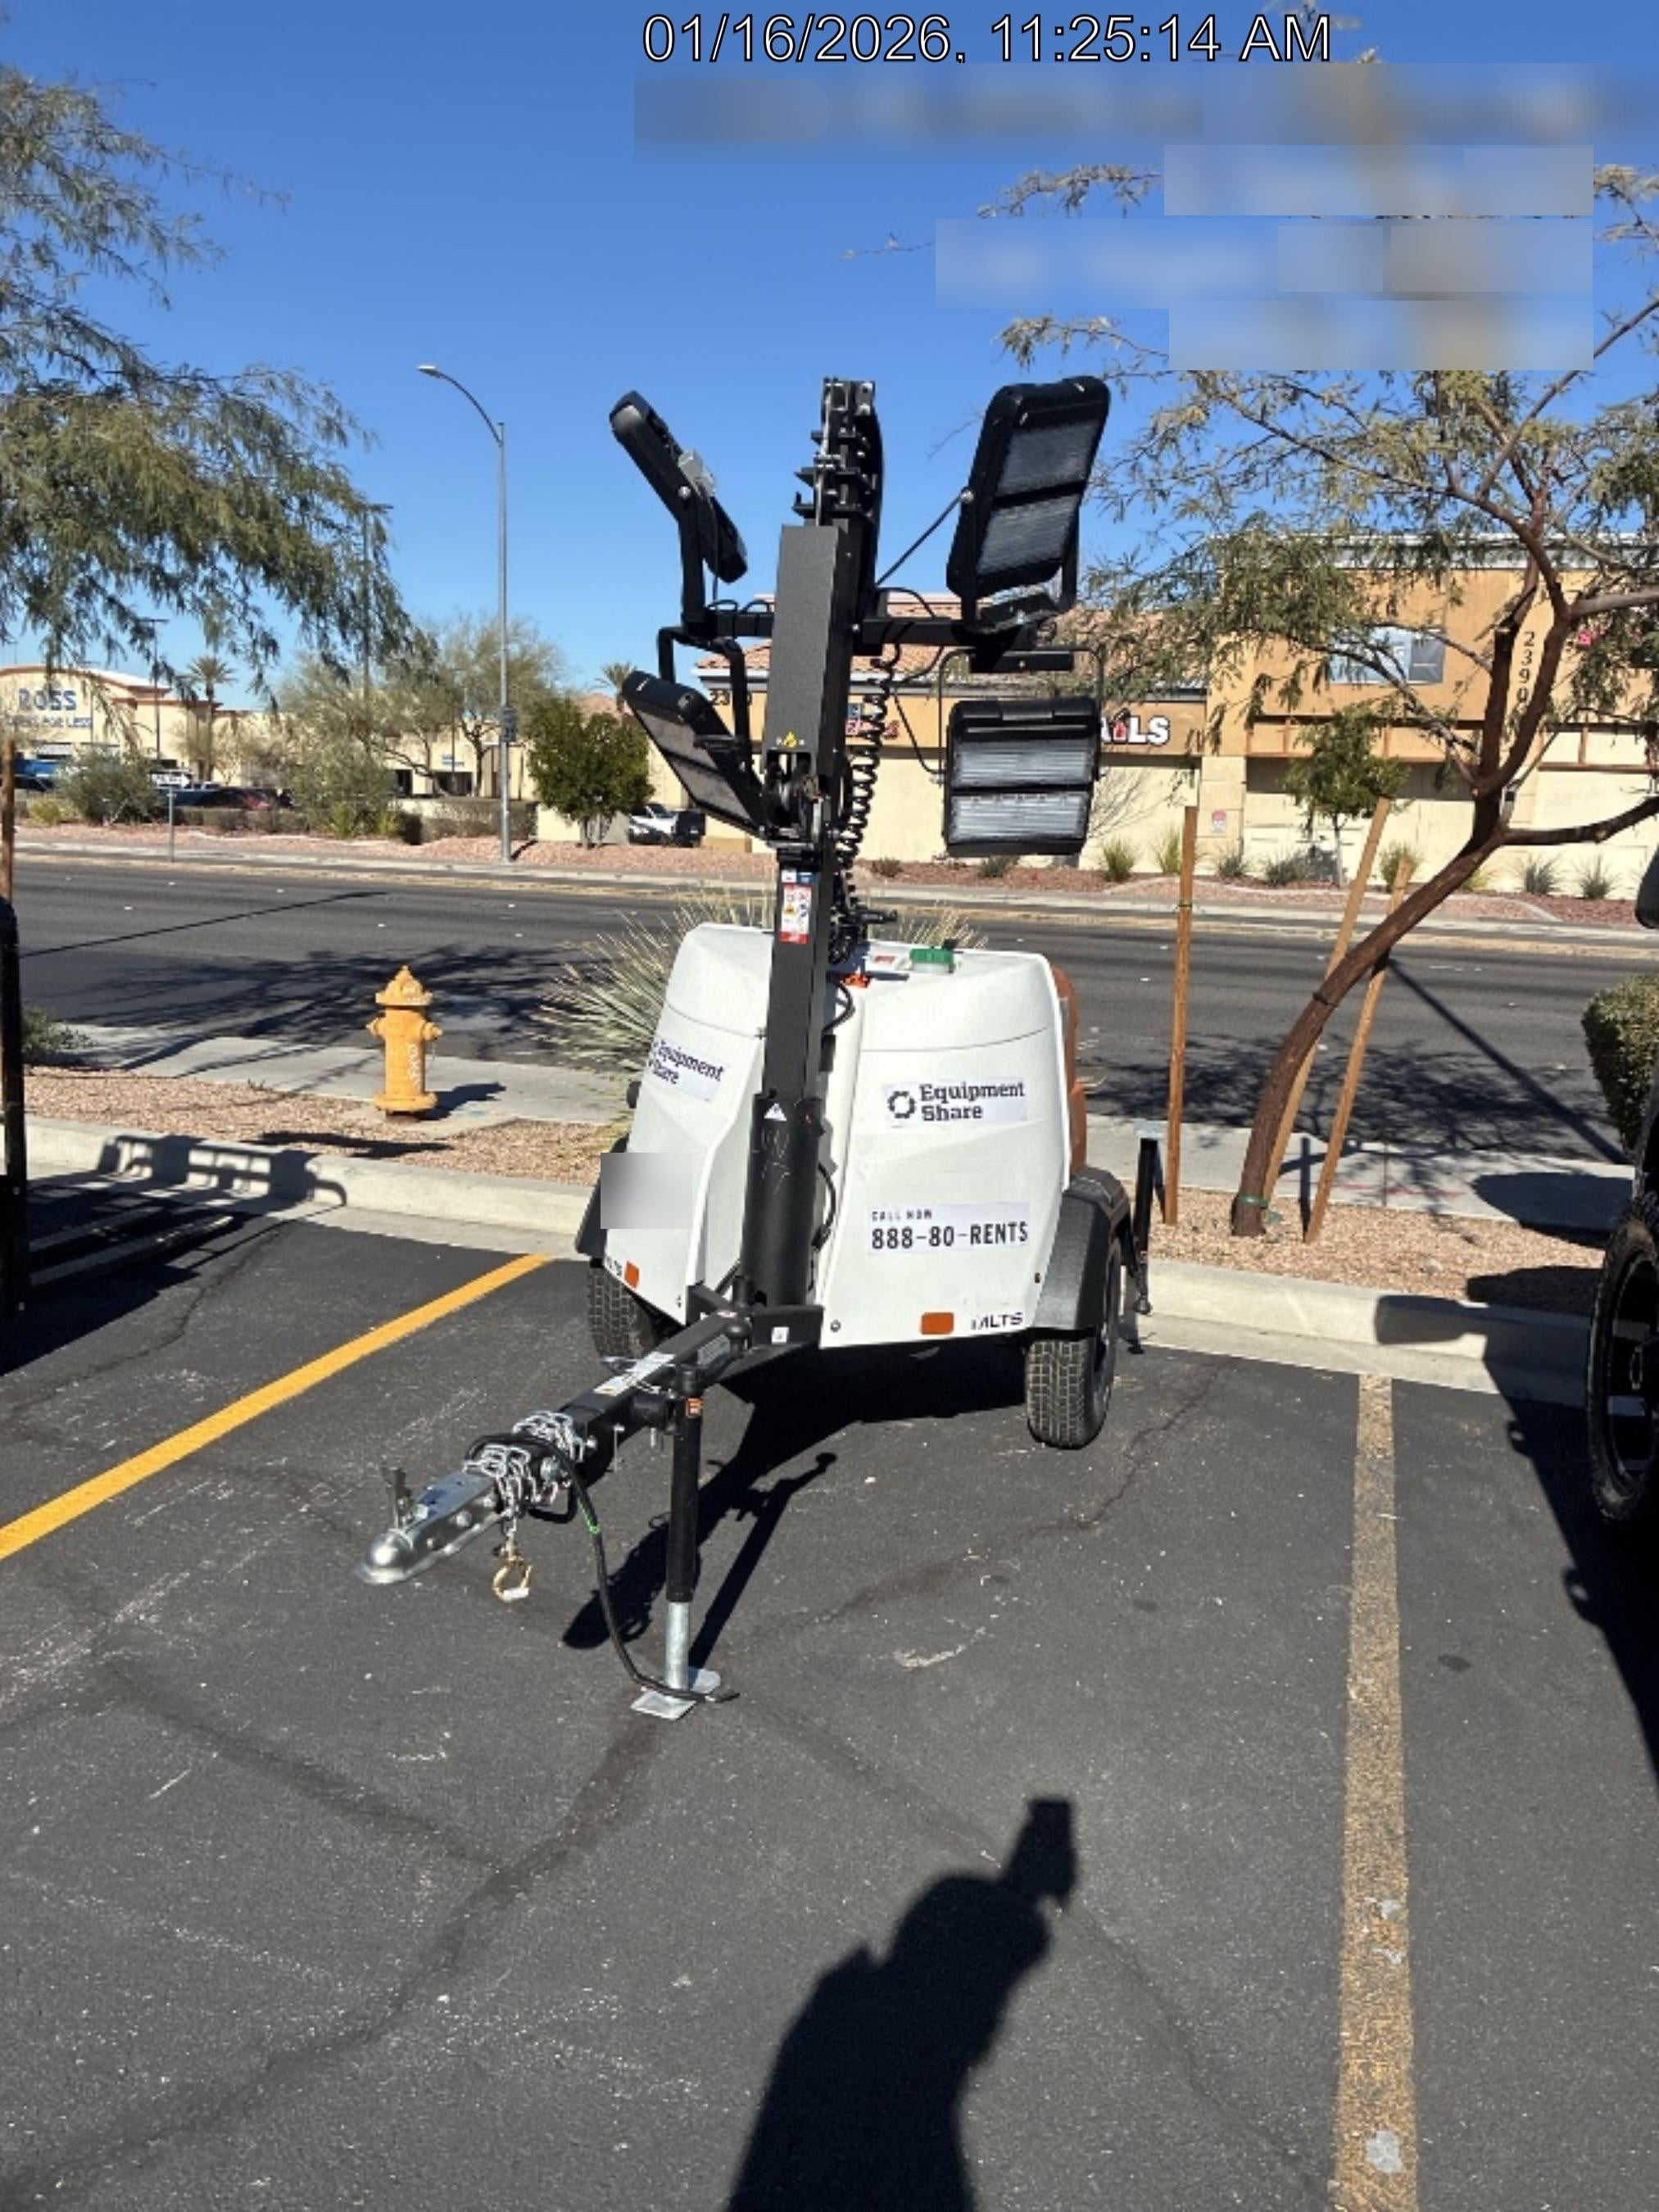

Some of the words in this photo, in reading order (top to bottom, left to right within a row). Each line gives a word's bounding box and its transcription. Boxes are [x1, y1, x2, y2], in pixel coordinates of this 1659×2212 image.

[1516, 630, 1535, 703] 2390
[18, 687, 77, 711] ROSS
[919, 1081, 1025, 1104] Equipment
[922, 1104, 983, 1122] Share
[906, 1208, 932, 1220] NOW
[872, 1221, 1028, 1249] 888-80-RENTS
